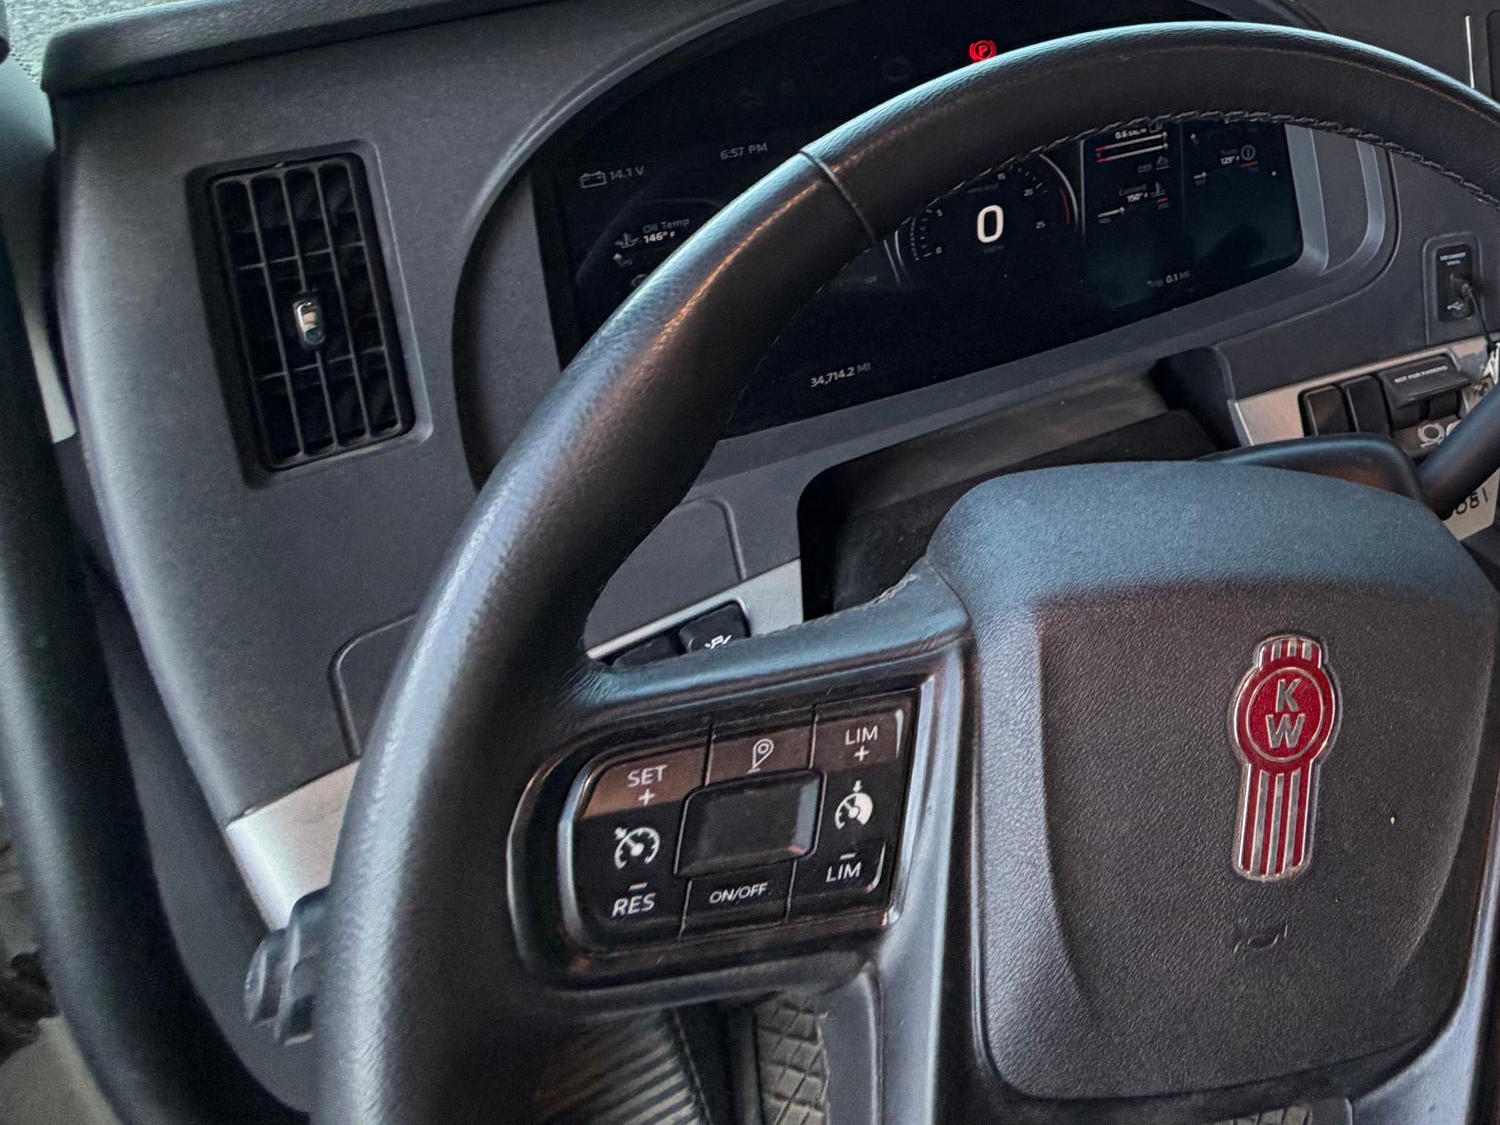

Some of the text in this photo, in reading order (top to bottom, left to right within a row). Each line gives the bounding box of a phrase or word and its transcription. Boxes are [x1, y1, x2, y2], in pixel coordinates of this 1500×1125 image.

[720, 143, 768, 160] 6:57 PM
[610, 166, 645, 180] 14.1 V
[642, 217, 691, 235] Oil Temp
[976, 204, 1004, 244] 0
[810, 363, 872, 388] 34,714.2 MI
[1275, 678, 1302, 714] K
[844, 725, 880, 746] LIM
[1265, 713, 1306, 749] W
[627, 764, 668, 789] SET
[825, 861, 863, 884] LIM
[708, 881, 769, 905] ON/OFF
[611, 892, 657, 919] RES
